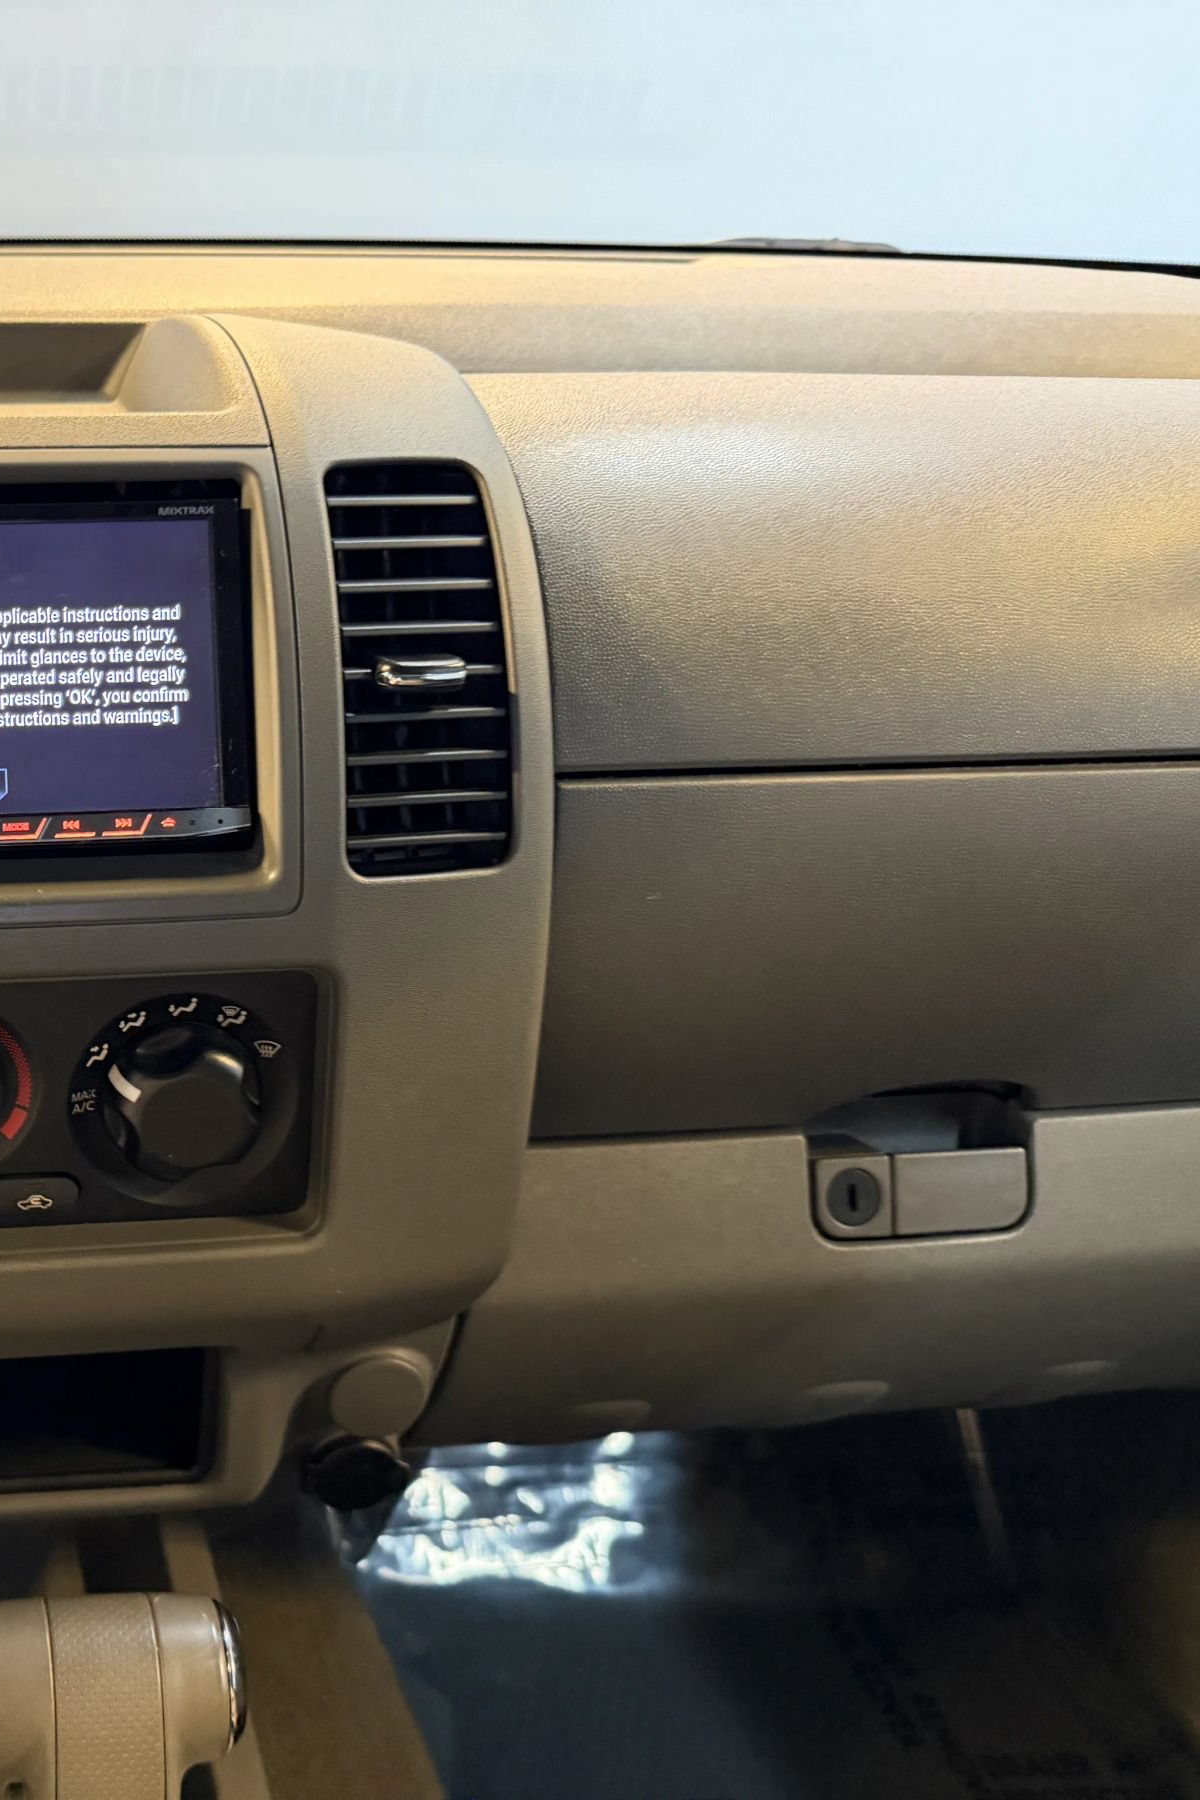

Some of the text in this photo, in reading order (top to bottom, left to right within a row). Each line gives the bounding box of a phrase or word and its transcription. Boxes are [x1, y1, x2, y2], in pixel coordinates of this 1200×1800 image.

[158, 505, 214, 516] MIXTRAX
[63, 604, 149, 622] instructions
[152, 604, 180, 620] and
[14, 627, 56, 644] result
[60, 627, 73, 643] in
[76, 626, 130, 642] serious
[133, 625, 177, 645] injury,
[30, 648, 87, 669] glances
[90, 648, 106, 664] to
[109, 648, 132, 664] the
[136, 647, 186, 667] device,
[58, 669, 103, 690] safely
[106, 668, 134, 685] and
[137, 668, 186, 688] legally
[0, 689, 62, 710] pressing
[102, 691, 130, 708] you
[133, 686, 190, 703] confirm
[72, 710, 100, 726] and
[103, 709, 179, 728] warnings.]
[3, 822, 29, 832] MODE
[72, 1088, 96, 1103] MAX
[72, 1100, 95, 1115] A/C
